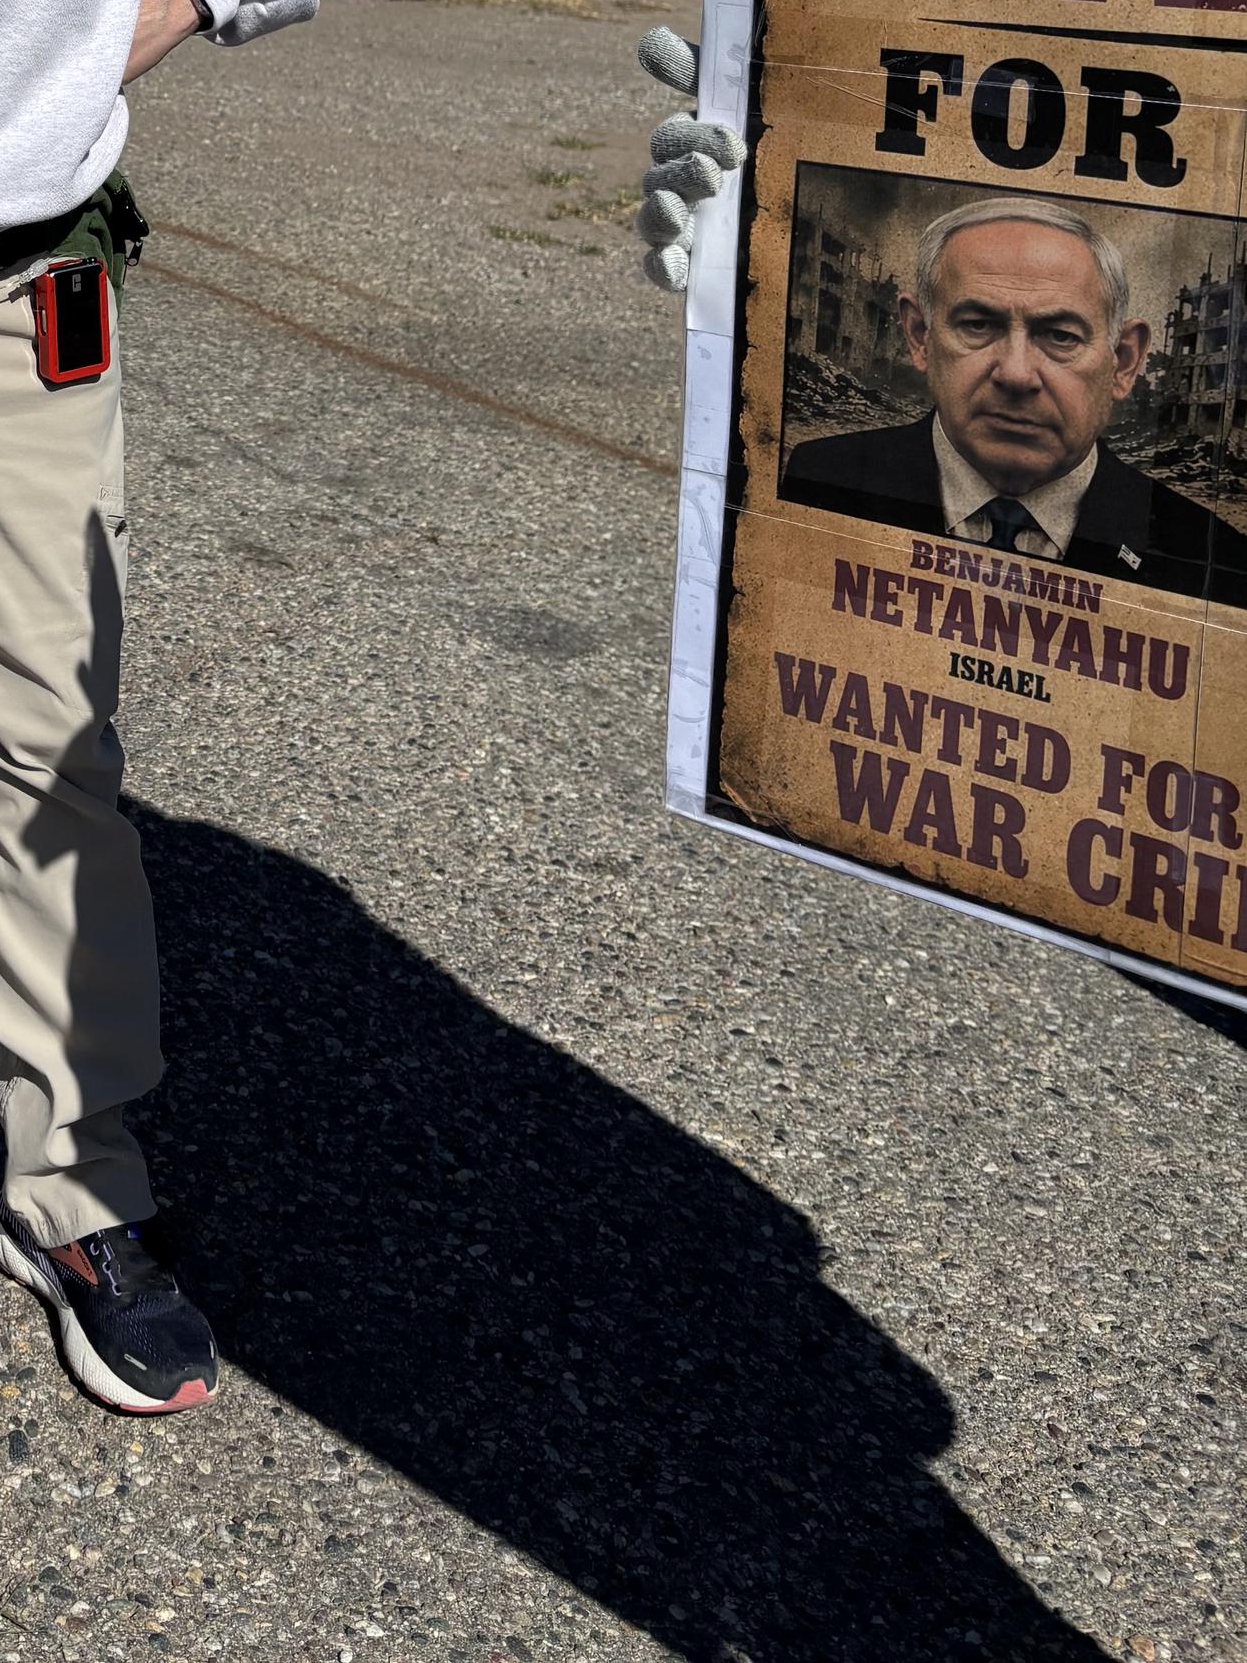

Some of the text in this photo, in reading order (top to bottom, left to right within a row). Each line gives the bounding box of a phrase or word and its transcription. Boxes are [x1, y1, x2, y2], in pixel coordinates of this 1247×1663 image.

[875, 48, 1187, 189] FOR
[831, 558, 1191, 701] NETANYAHU
[910, 539, 1104, 614] BENJAMIN
[949, 651, 1052, 703] ISRAEL
[774, 651, 1244, 850] WANTED FOR
[829, 740, 1247, 953] WAR CRI
